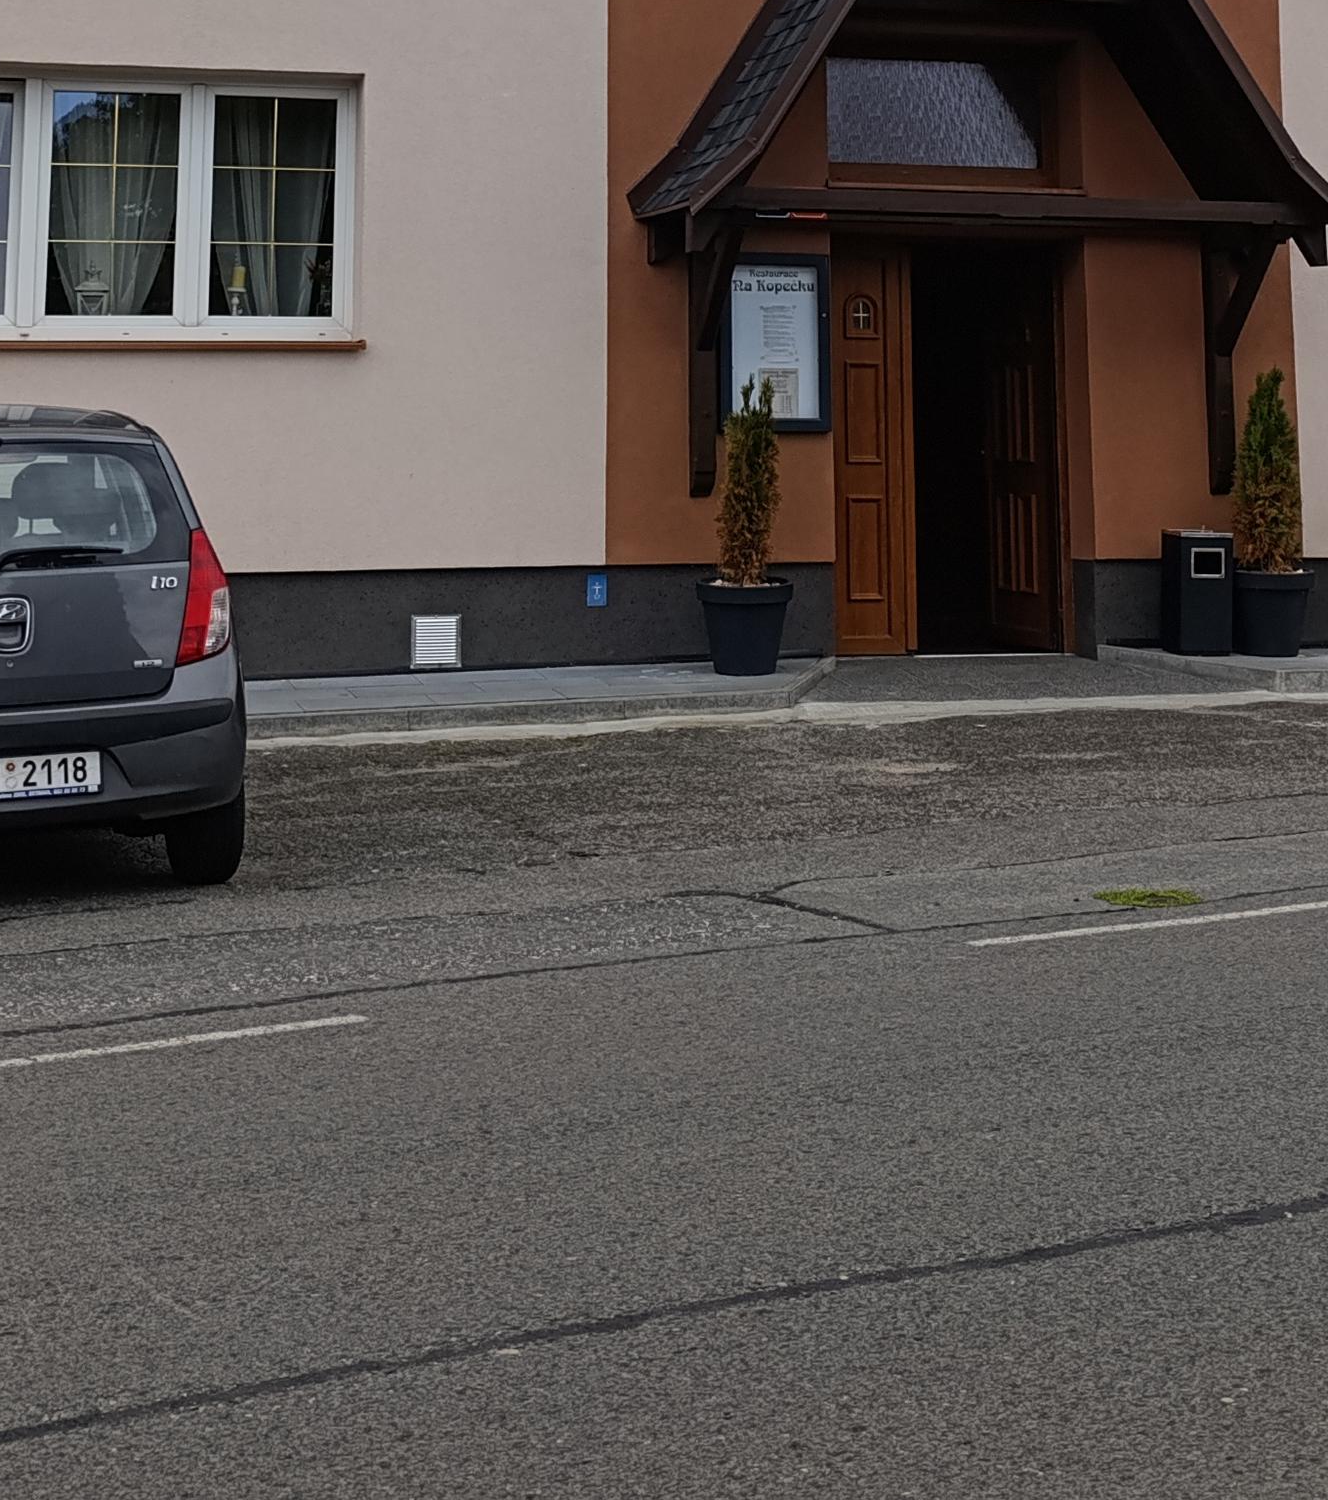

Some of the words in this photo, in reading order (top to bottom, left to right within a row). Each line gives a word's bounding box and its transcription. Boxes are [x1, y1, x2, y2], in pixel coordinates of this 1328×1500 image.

[748, 268, 799, 278] Restaurace
[733, 279, 752, 292] Na
[757, 279, 815, 294] Kopečku
[151, 575, 178, 589] i10
[22, 756, 88, 787] 2118
